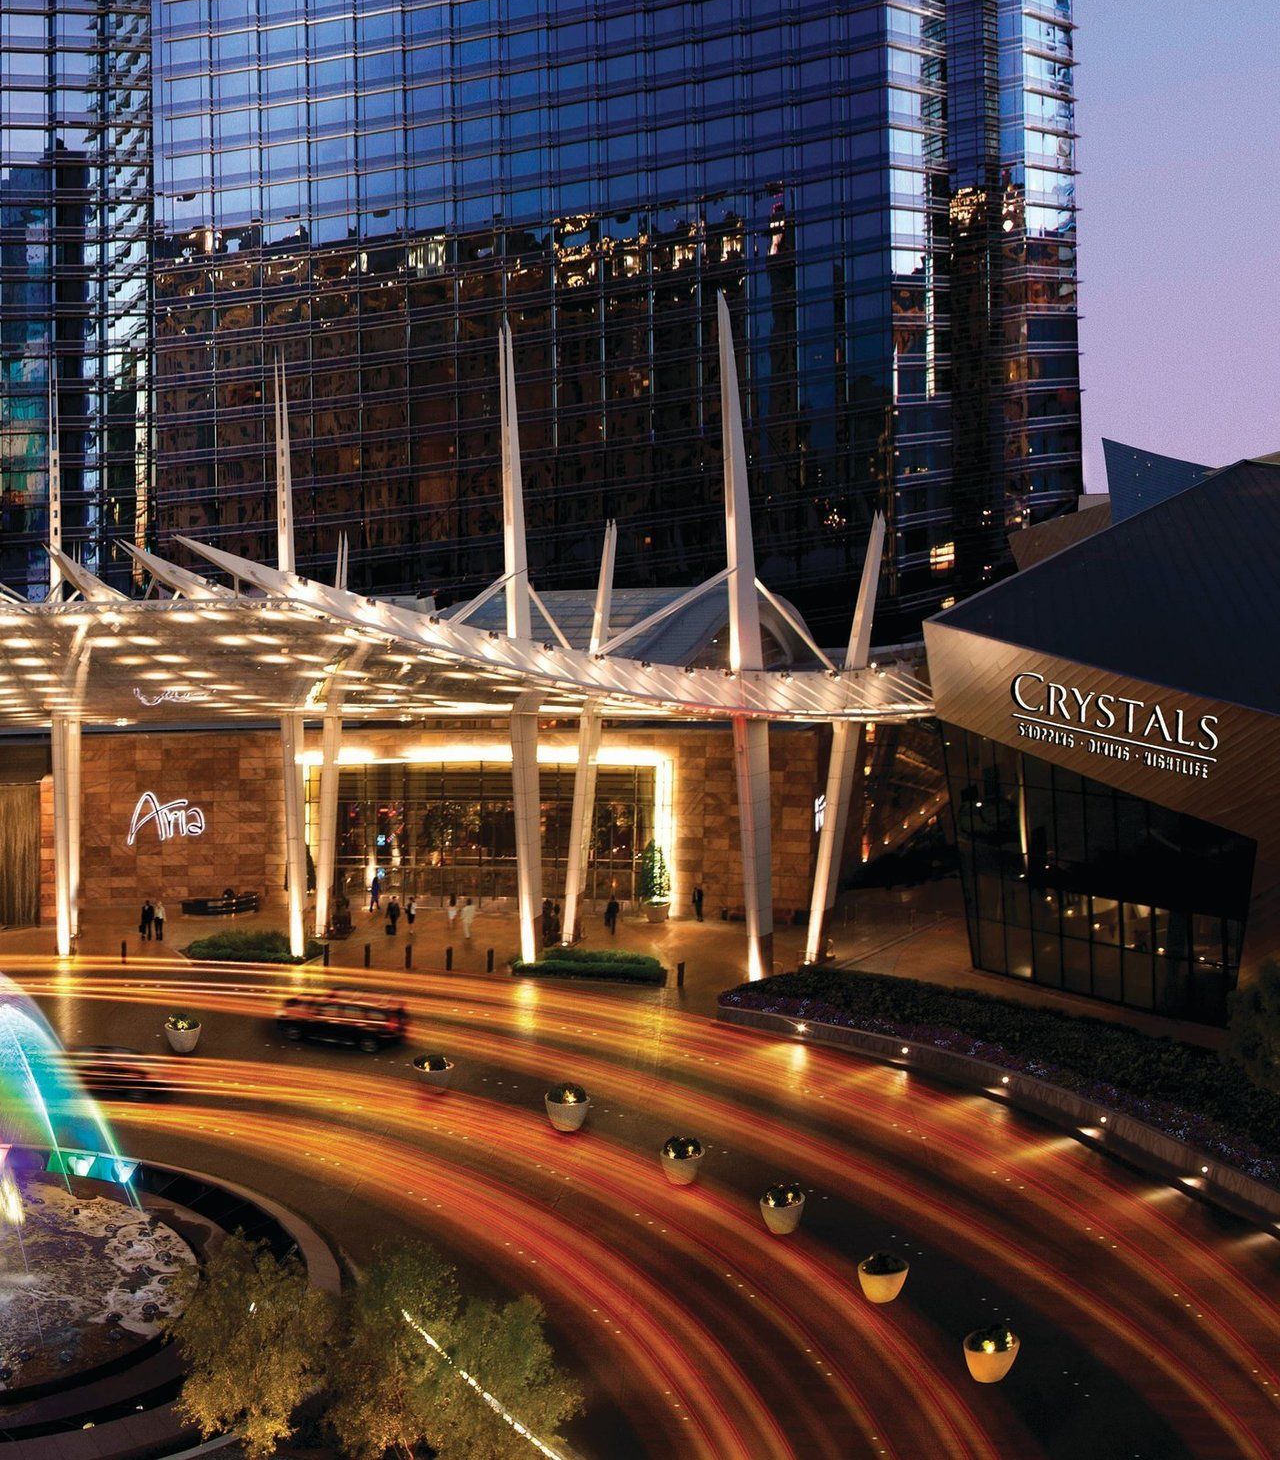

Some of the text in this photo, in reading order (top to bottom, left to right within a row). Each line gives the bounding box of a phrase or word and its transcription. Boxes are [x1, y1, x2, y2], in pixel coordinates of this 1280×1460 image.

[1011, 671, 1219, 751] CRYSTALS
[1143, 750, 1209, 778] NIGHTLIFE
[127, 791, 206, 846] Aria
